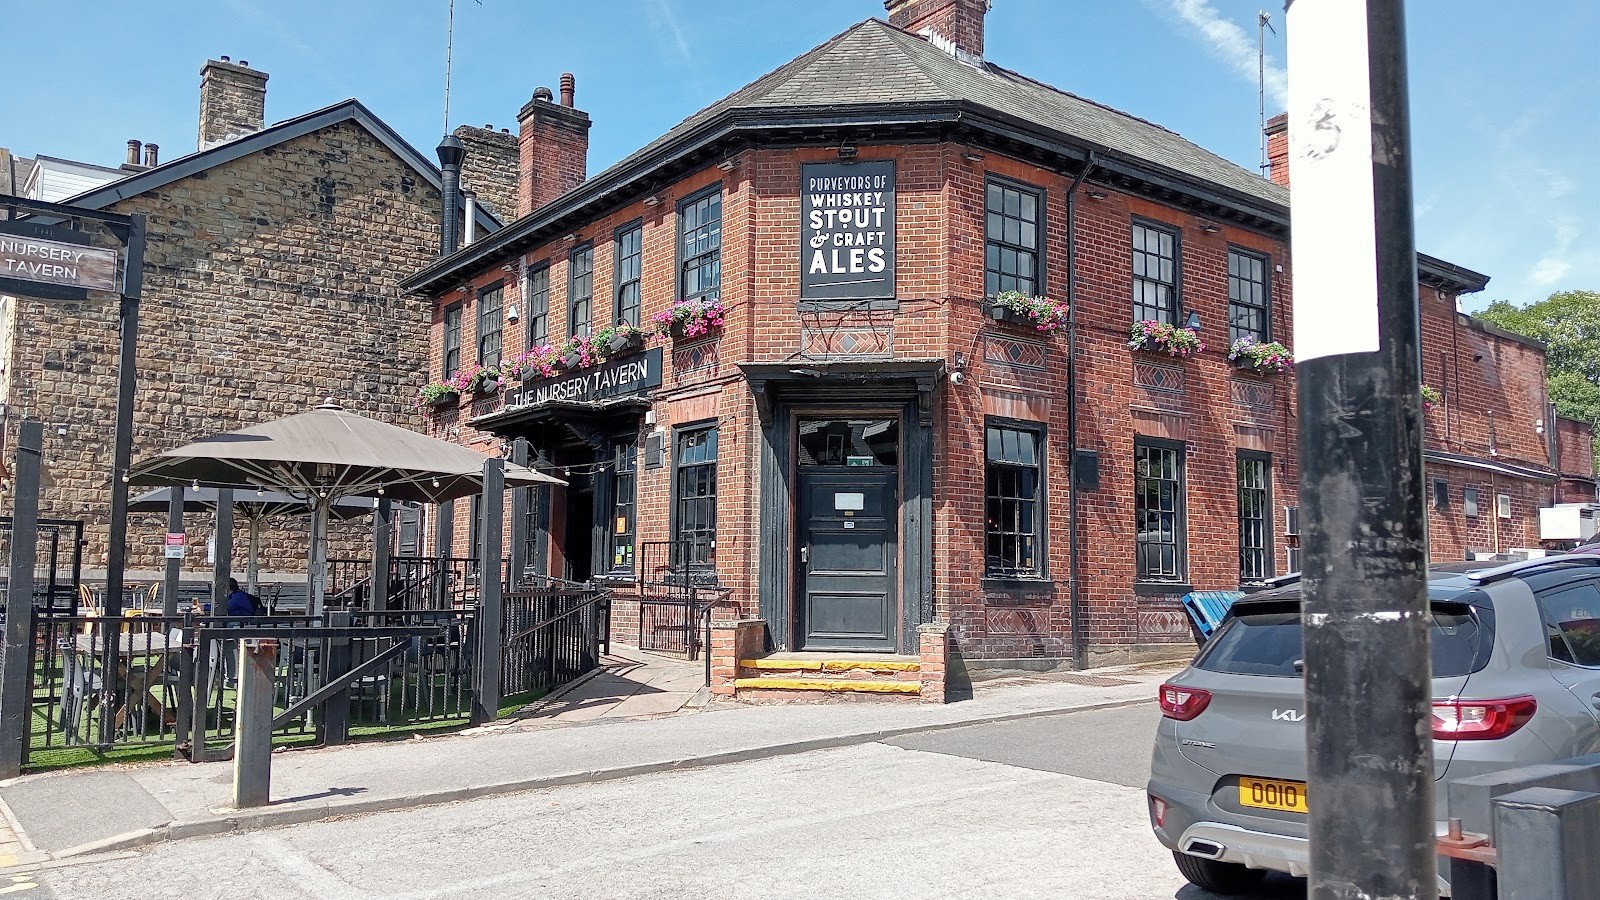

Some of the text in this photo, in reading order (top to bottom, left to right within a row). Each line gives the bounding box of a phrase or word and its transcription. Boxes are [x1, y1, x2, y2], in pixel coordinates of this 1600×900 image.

[810, 175, 887, 191] PURVEYORS OF
[810, 192, 886, 207] WHISKEY,
[809, 207, 886, 230] STOUT
[809, 230, 886, 248] & CRAFT
[0, 240, 85, 265] NURSERY
[808, 247, 887, 274] ALES
[5, 258, 78, 280] TAVERN
[513, 358, 648, 406] THE NURSERY TAVERN
